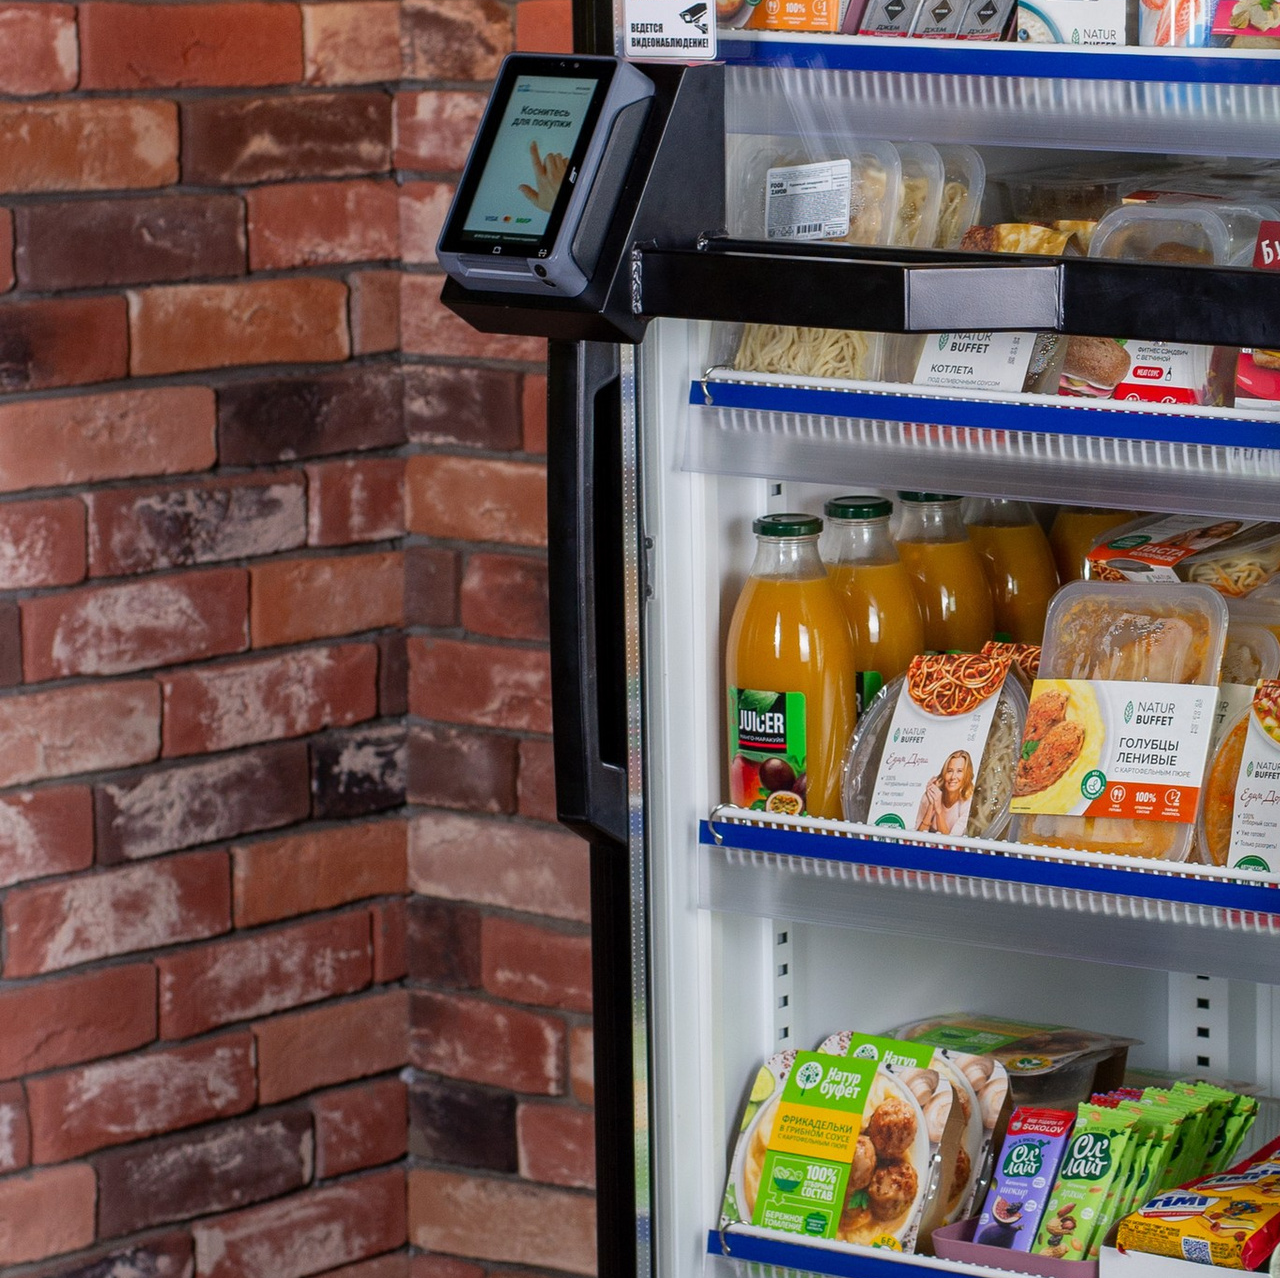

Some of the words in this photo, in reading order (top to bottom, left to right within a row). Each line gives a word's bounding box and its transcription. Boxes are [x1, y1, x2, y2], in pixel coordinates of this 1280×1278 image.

[630, 23, 664, 34] ВЕДЕТСЯ
[1083, 29, 1117, 40] NATUR
[631, 37, 709, 49] ВИДЕОНАБЛЮДЕНИЕ!
[521, 105, 571, 117] Коснитесь
[511, 118, 531, 127] для
[531, 119, 572, 130] покупки
[950, 342, 990, 354] BUFFET
[930, 364, 974, 375] КОТЛЕТА
[1138, 544, 1186, 558] ПАСТА
[1137, 701, 1176, 714] NATUR
[739, 709, 785, 734] JUICER
[1136, 714, 1174, 726] BUFFET
[902, 727, 927, 736] NATUR
[900, 736, 924, 744] BUFFET
[1119, 737, 1180, 752] ГОЛУБЦЫ
[1116, 752, 1177, 766] ЛЕНИВЫЕ
[1119, 767, 1171, 777] КАРТОФЕЛЬНЫМ
[1171, 770, 1191, 778] ПЮРЕ
[1254, 771, 1280, 780] BUFFET
[1135, 791, 1157, 803] 100%
[827, 1067, 862, 1086] Натур
[820, 1083, 861, 1100] буфет
[782, 1115, 853, 1133] ФРИКАДЕЛЬКИ
[1022, 1123, 1064, 1134] SOKOLOV
[785, 1126, 824, 1138] ГРИБНОМ
[825, 1132, 850, 1143] СОУСЕ
[806, 1164, 838, 1184] 100%
[803, 1180, 834, 1190] ОТБОРНЫЙ
[801, 1187, 833, 1201] СОСТАВ
[765, 1209, 804, 1223] БЕРЕЖНОЕ
[764, 1218, 802, 1231] ТОМЛЕНИЕ
[881, 1236, 897, 1248] БЕЗ
